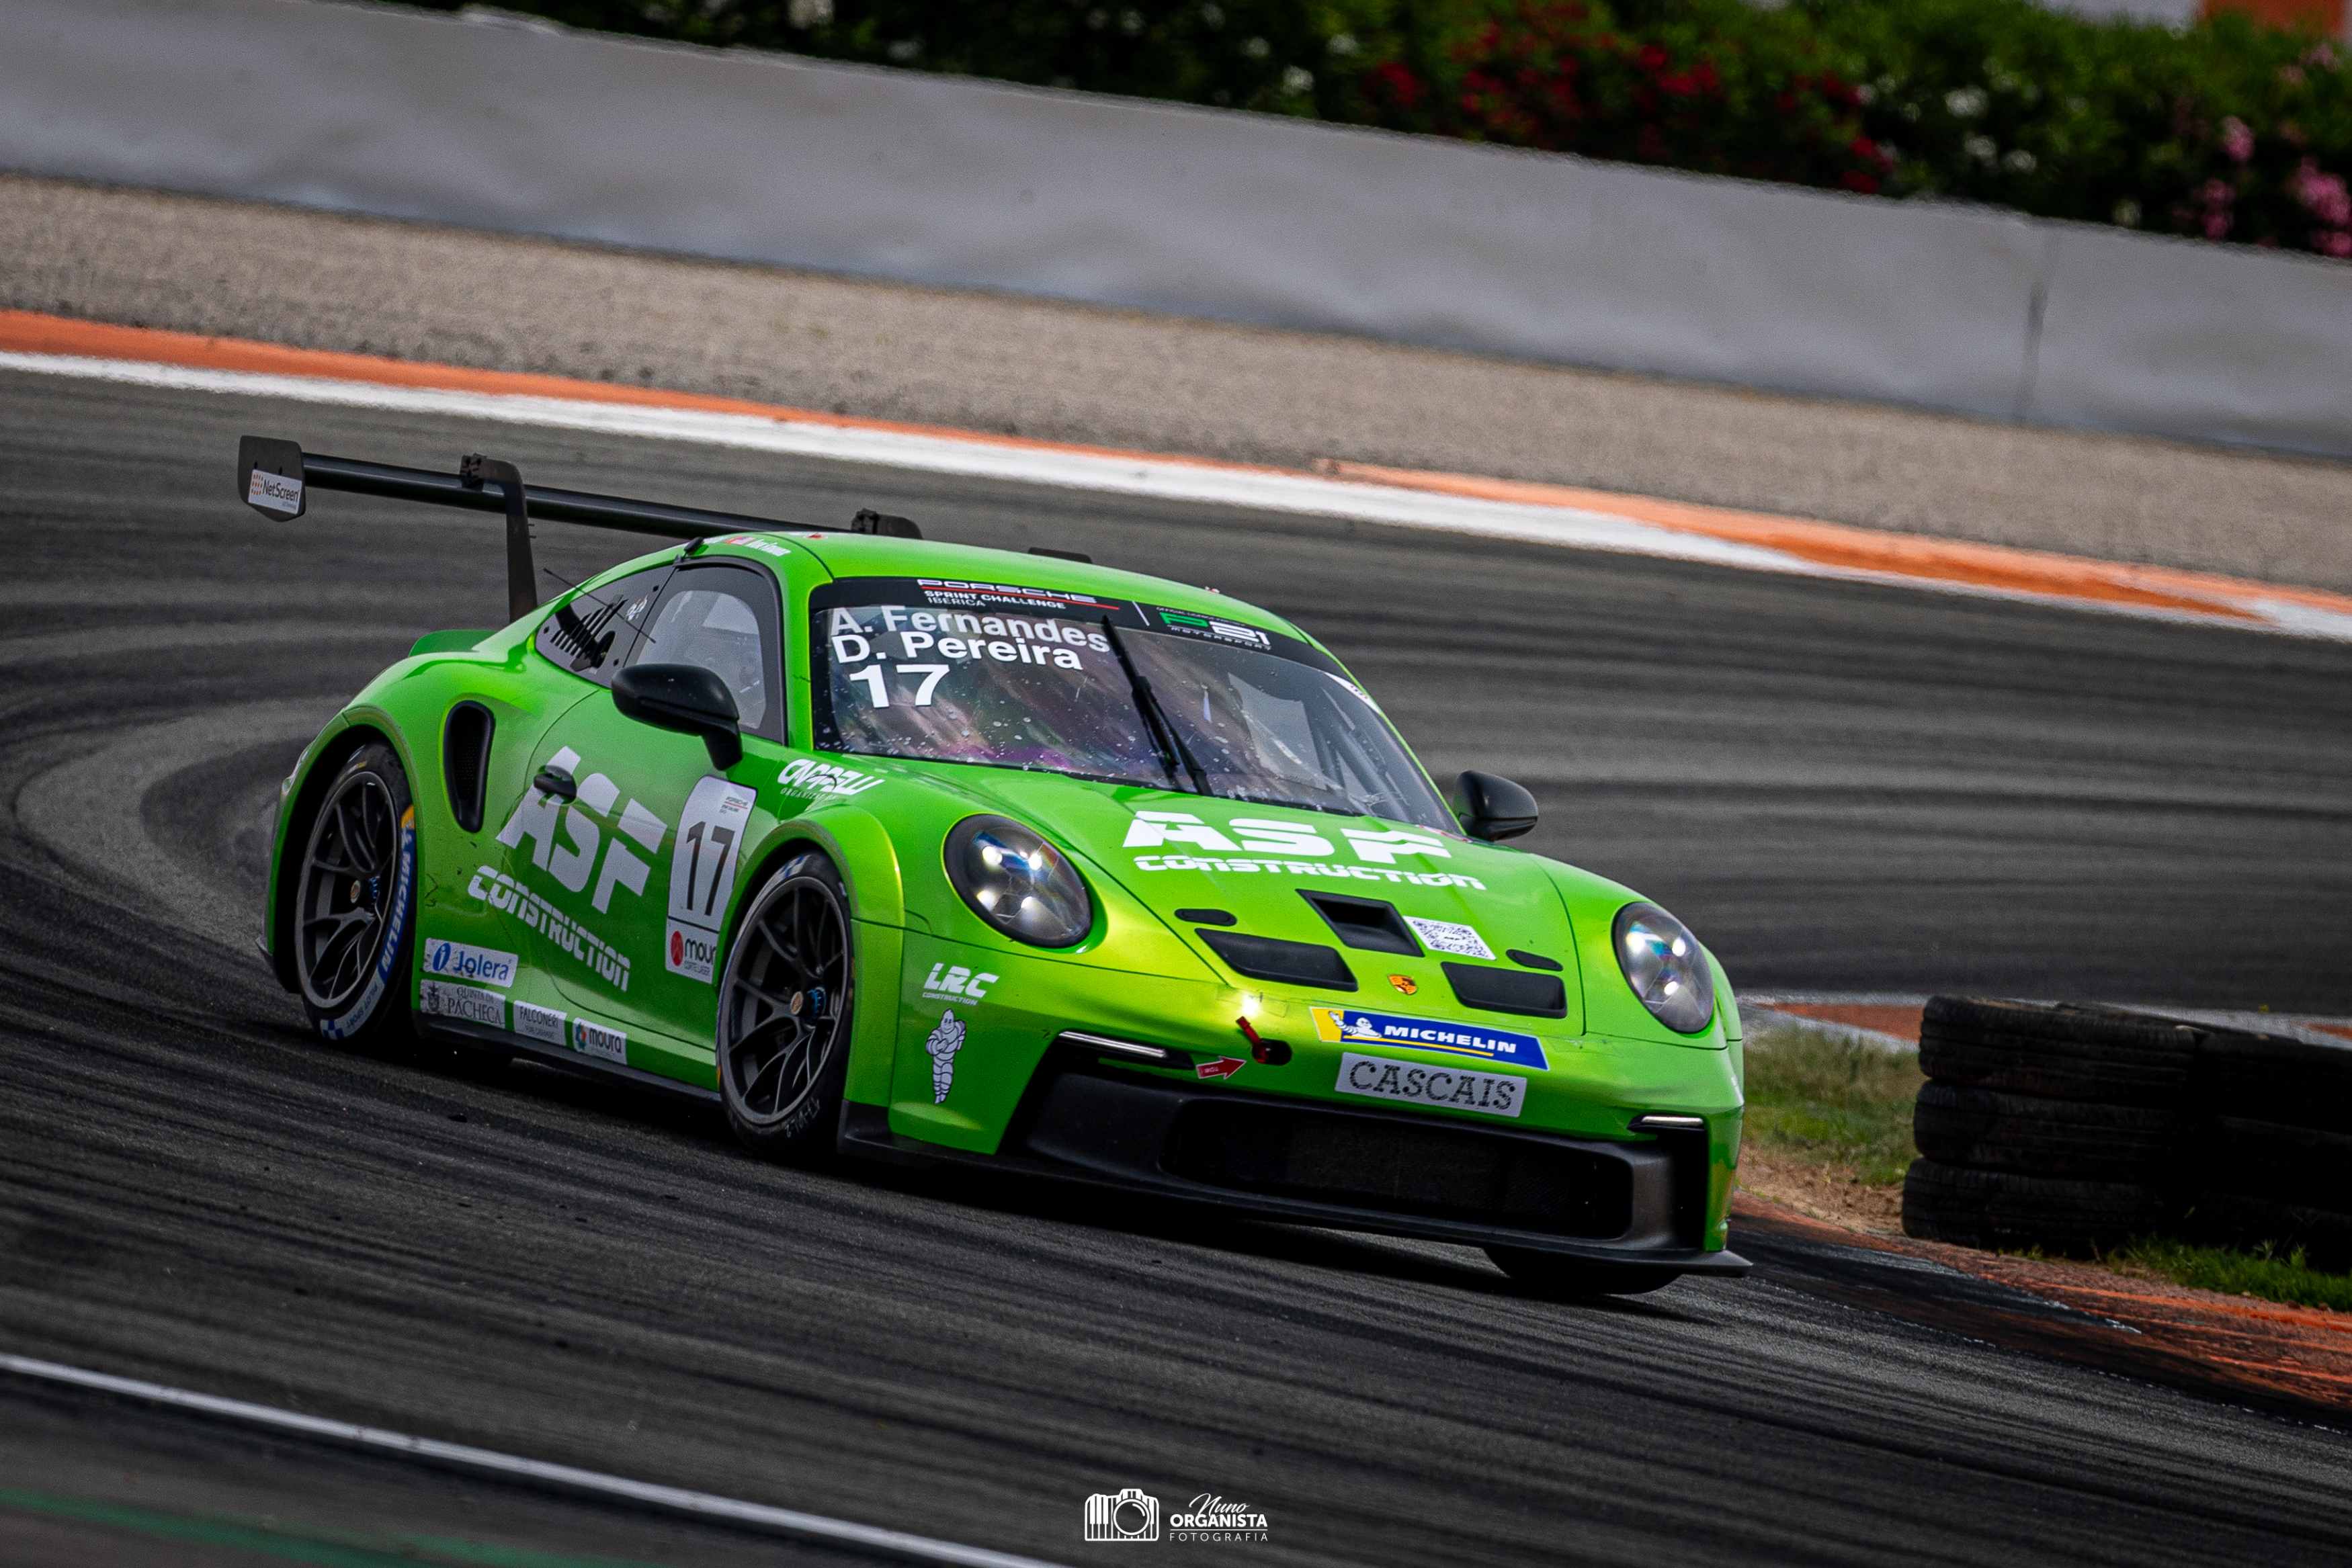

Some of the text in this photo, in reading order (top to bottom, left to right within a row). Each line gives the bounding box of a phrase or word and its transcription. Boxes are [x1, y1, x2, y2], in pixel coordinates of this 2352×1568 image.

[263, 479, 298, 503] NetScreen
[917, 579, 1097, 604] PORSCHE
[924, 591, 1066, 609] SPRINT CHALLENGE
[928, 597, 986, 608] IBERICA
[831, 605, 1110, 653] A. Fernandes
[1159, 612, 1271, 646] P21
[831, 631, 1083, 670] D. Pereira
[849, 664, 950, 709] 17
[495, 746, 667, 914] ASF
[1122, 810, 1452, 864] ASF
[686, 820, 735, 916] 17
[381, 851, 411, 973] MICHELIN
[454, 950, 509, 981] Jolera
[923, 963, 1000, 998] LRC
[448, 998, 502, 1025] PACHECA
[589, 1028, 623, 1053] moura
[1384, 1025, 1517, 1053] MICHELIN
[1349, 1061, 1515, 1110] CASCAIS
